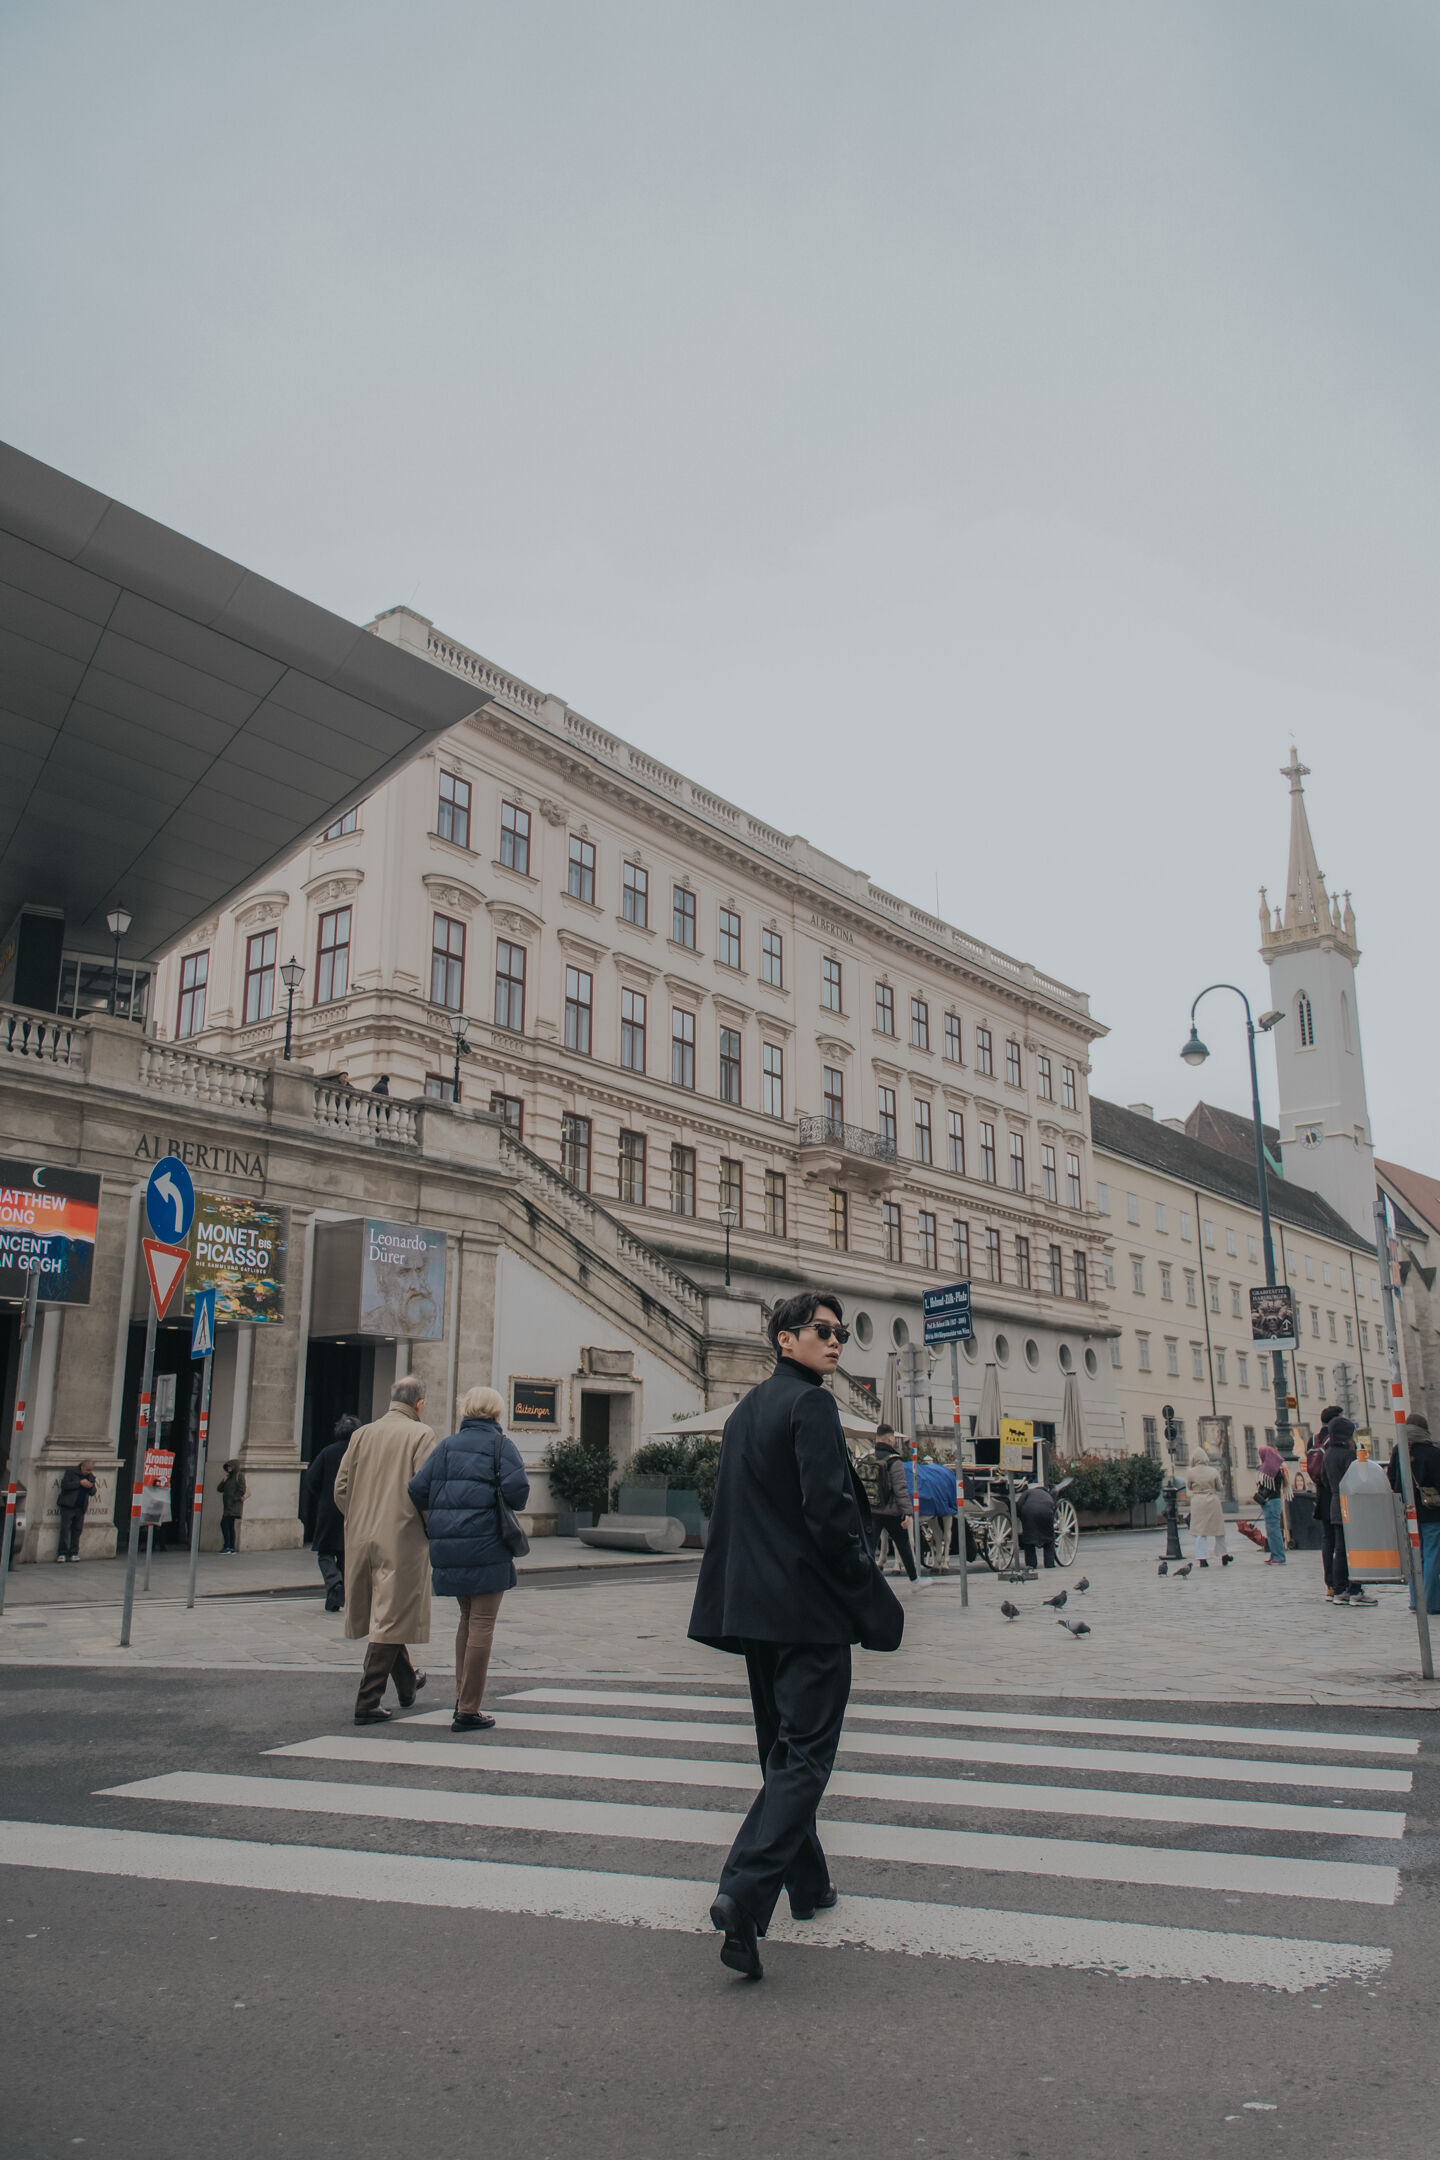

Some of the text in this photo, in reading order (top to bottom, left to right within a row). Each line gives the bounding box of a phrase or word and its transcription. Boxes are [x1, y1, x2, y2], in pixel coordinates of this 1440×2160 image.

[810, 913, 854, 944] ALBERTINA
[134, 1133, 265, 1178] ALBERTINA
[0, 1188, 67, 1212] ATTHEW
[0, 1206, 35, 1225] ONG
[0, 1234, 52, 1255] NCENT
[198, 1222, 272, 1250] MONET BIS
[369, 1228, 427, 1251] Leonardo
[196, 1242, 269, 1269] PICASSO
[369, 1245, 406, 1265] Dürer
[146, 1452, 174, 1465] Kronen
[144, 1464, 173, 1478] Zeitung
